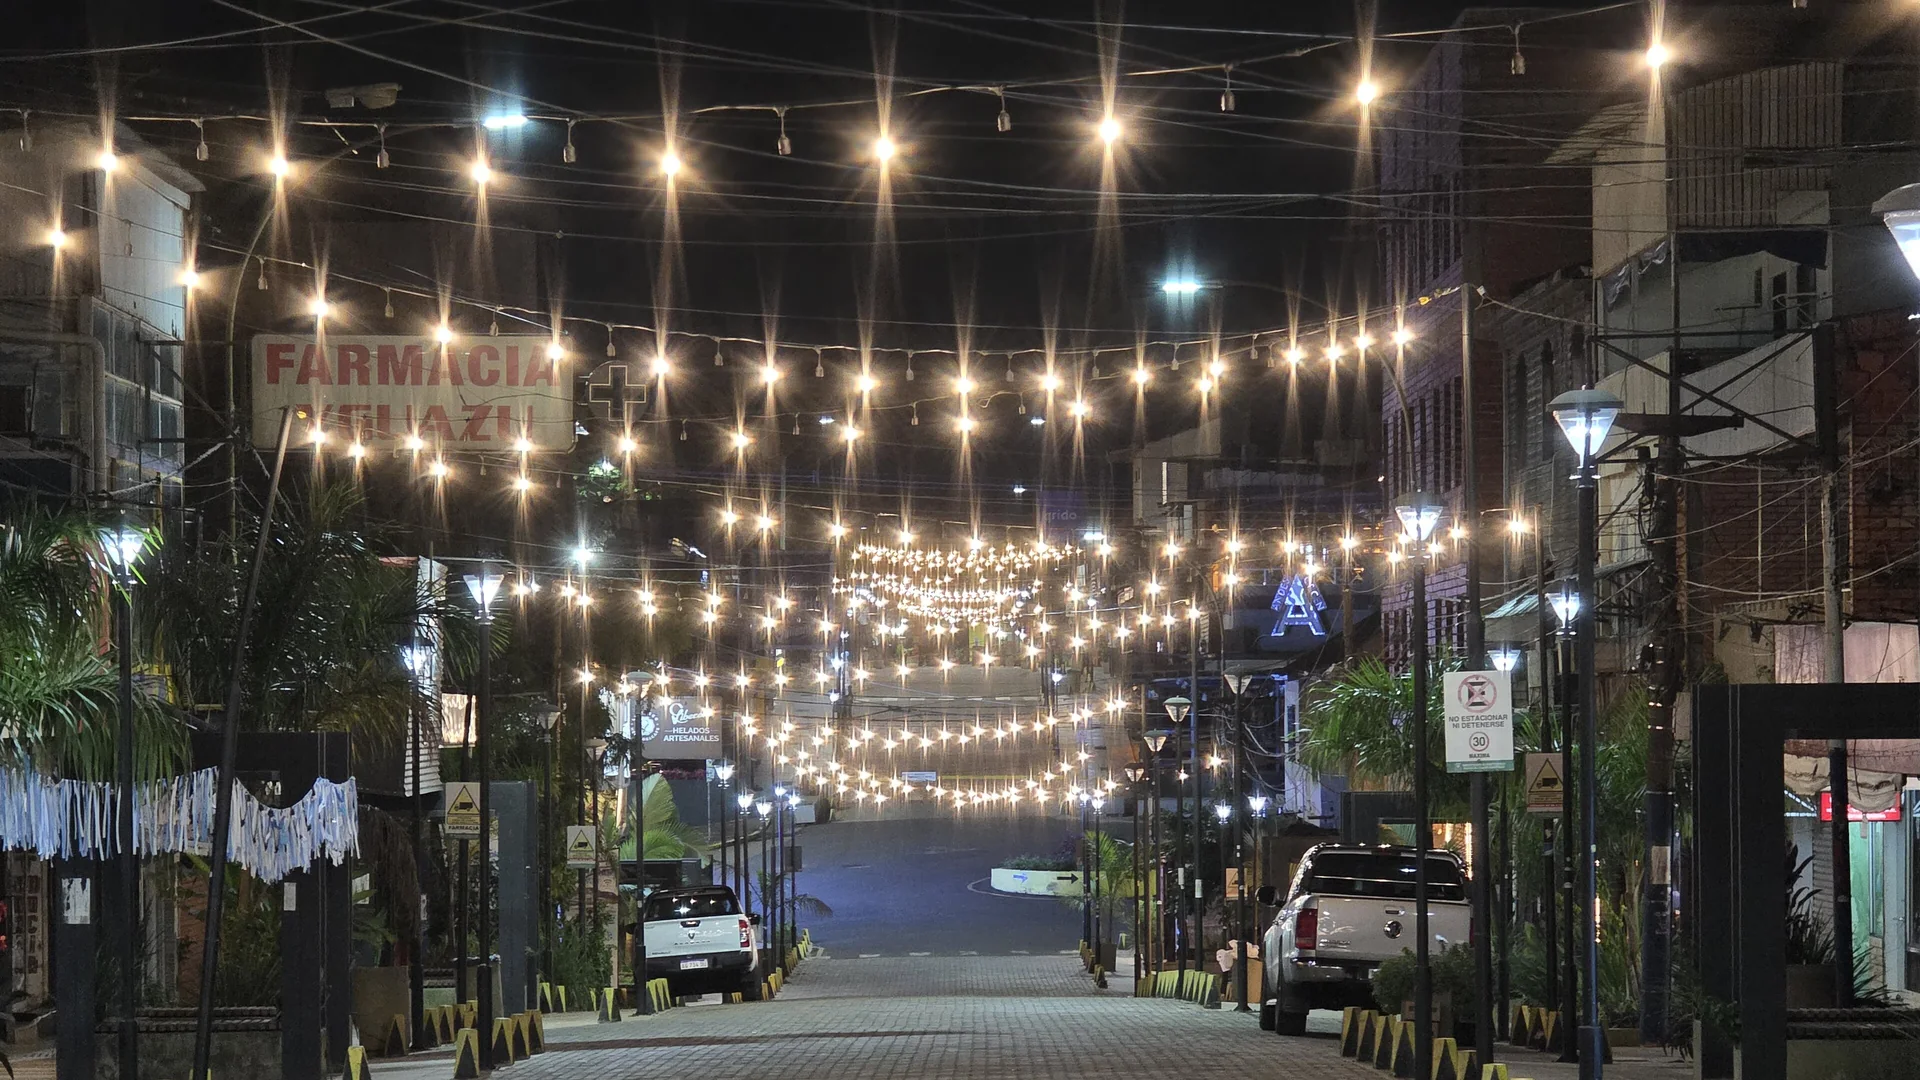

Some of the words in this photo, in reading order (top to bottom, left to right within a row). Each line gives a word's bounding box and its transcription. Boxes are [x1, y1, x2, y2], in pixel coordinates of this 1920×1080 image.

[266, 343, 561, 387] FARMACIA
[1461, 714, 1508, 722] ESTACIONAR
[1461, 721, 1505, 729] DETENERSE
[1472, 736, 1486, 747] 30
